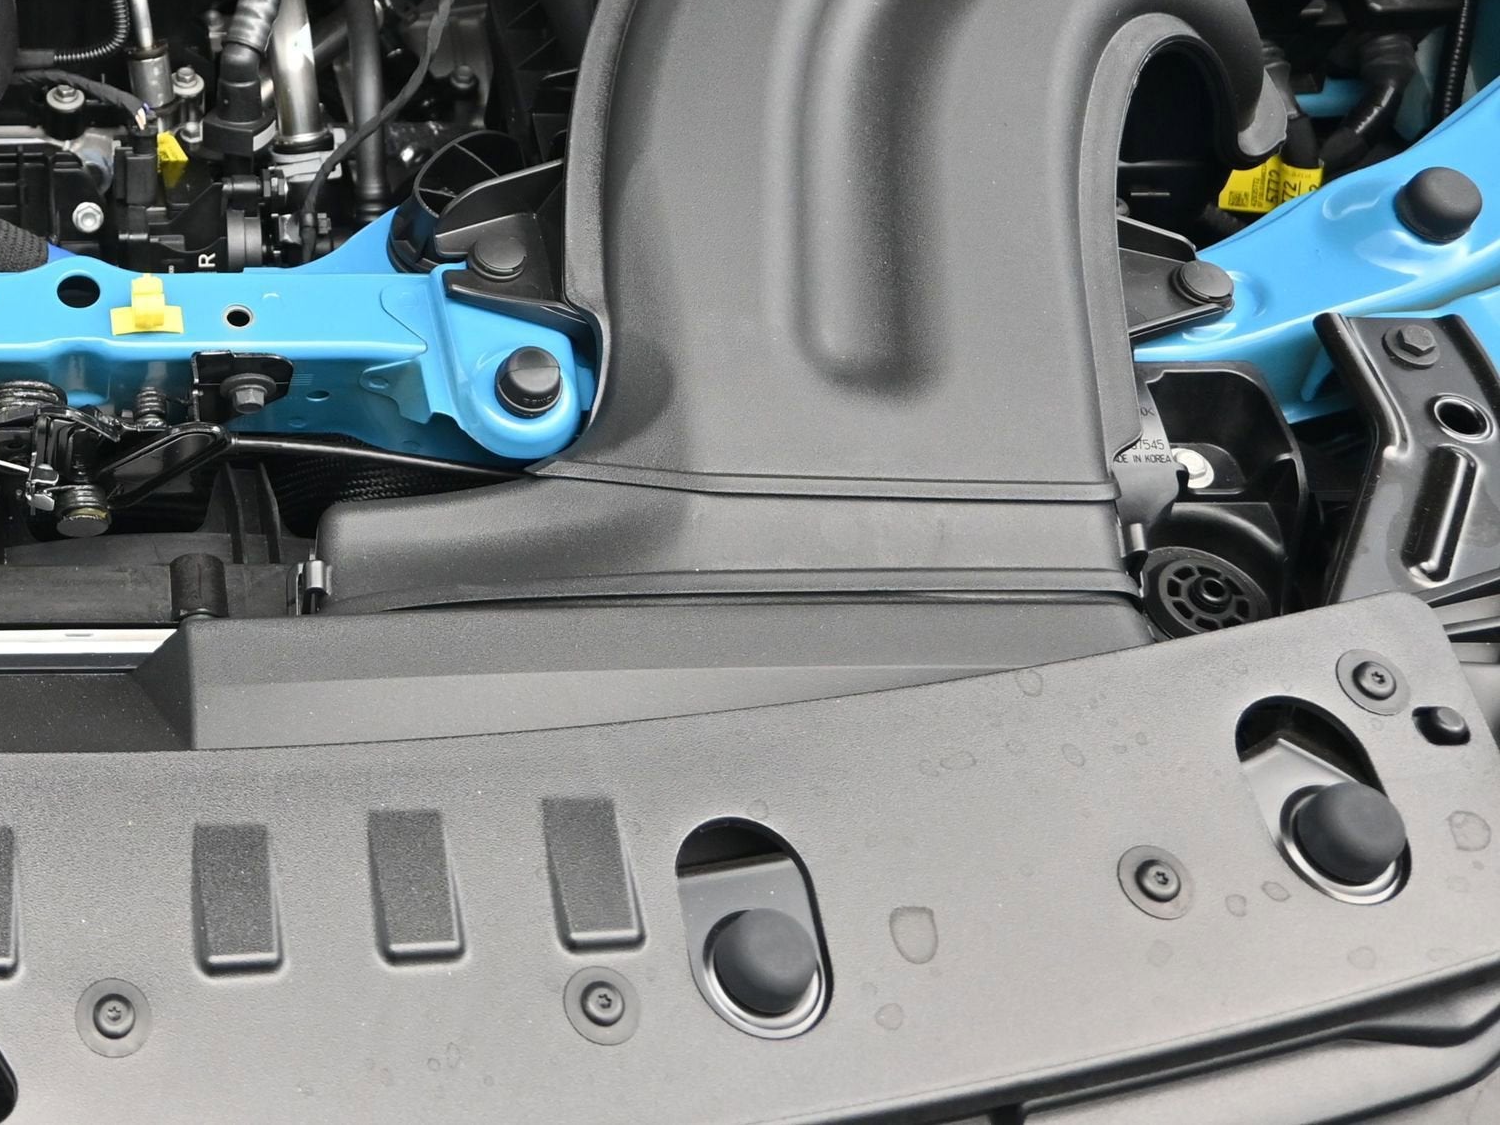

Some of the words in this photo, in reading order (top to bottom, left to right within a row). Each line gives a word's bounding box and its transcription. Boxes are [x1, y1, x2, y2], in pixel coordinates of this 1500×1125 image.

[197, 252, 217, 268] R
[1114, 454, 1129, 464] ADE
[1133, 455, 1142, 463] IN
[1145, 454, 1172, 464] KOREA
